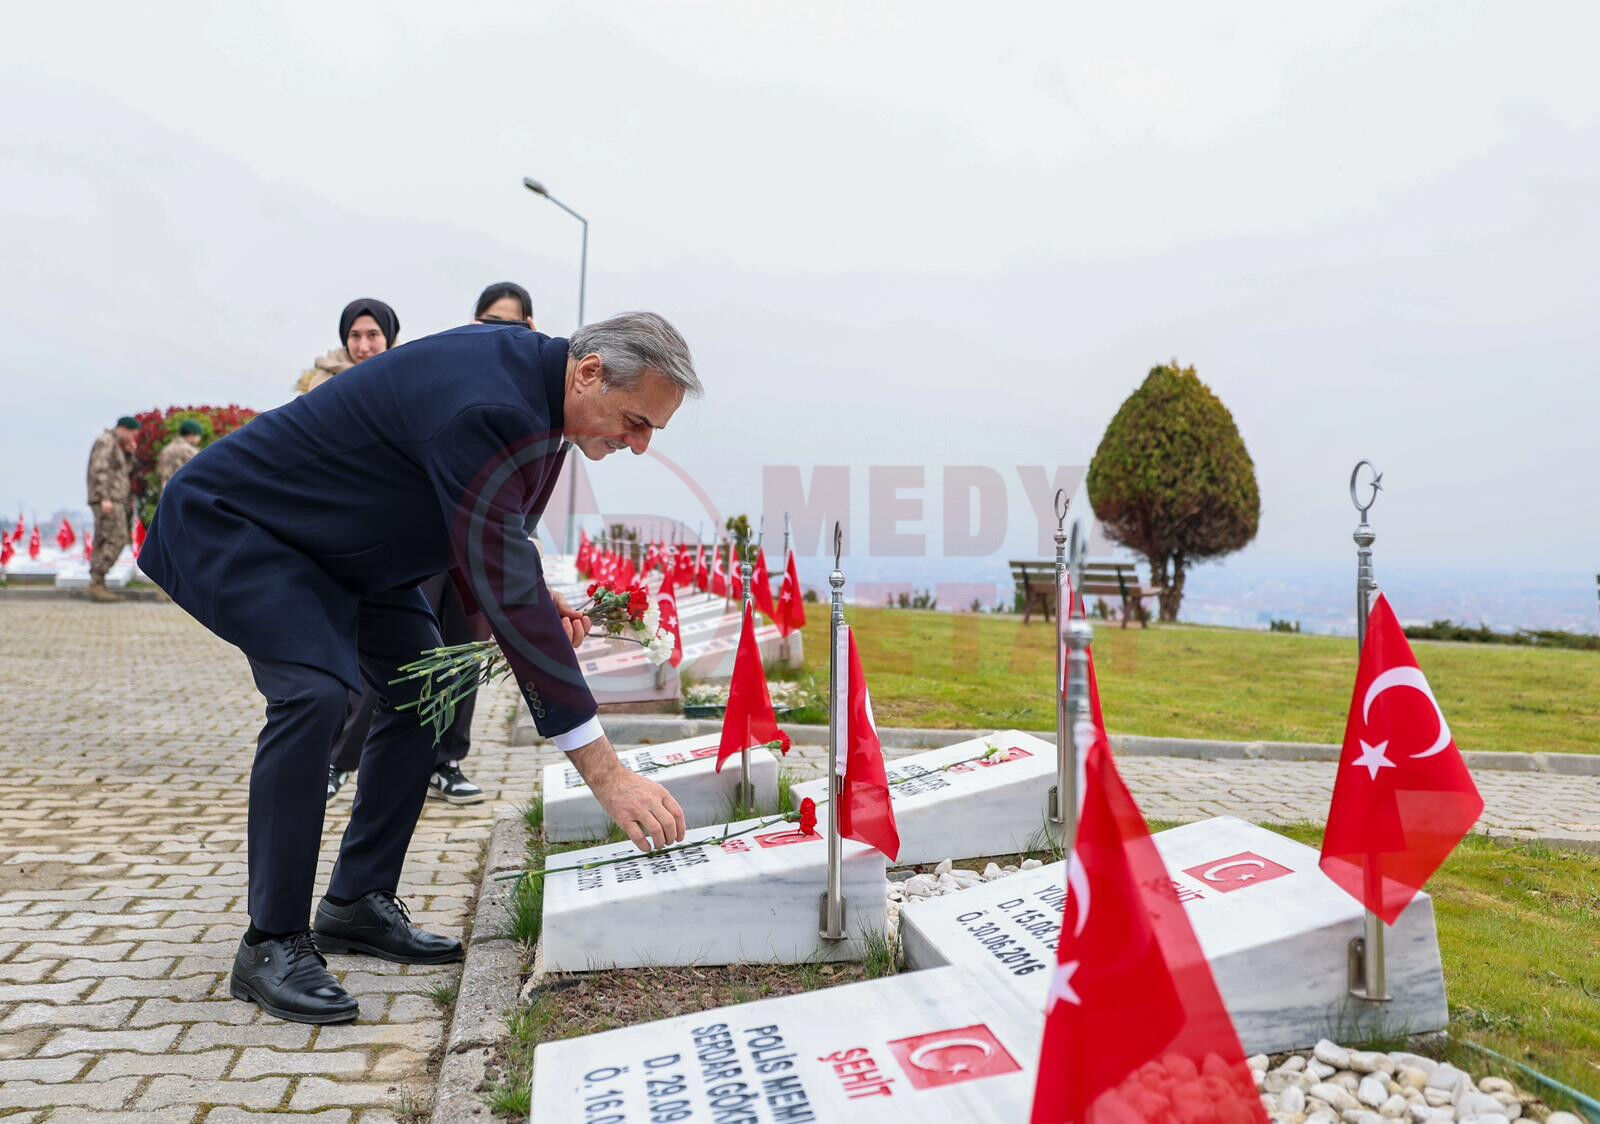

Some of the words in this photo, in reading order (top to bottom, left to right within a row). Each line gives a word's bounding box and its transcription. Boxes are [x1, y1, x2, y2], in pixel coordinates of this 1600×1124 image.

[967, 922, 1046, 976] 30.06.2016
[1011, 909, 1061, 955] 15.08.1
[691, 1023, 743, 1083] SERDAR
[743, 1024, 798, 1074] POLİS
[817, 1047, 895, 1100] ŞEHİT
[761, 1075, 818, 1124] MEM
